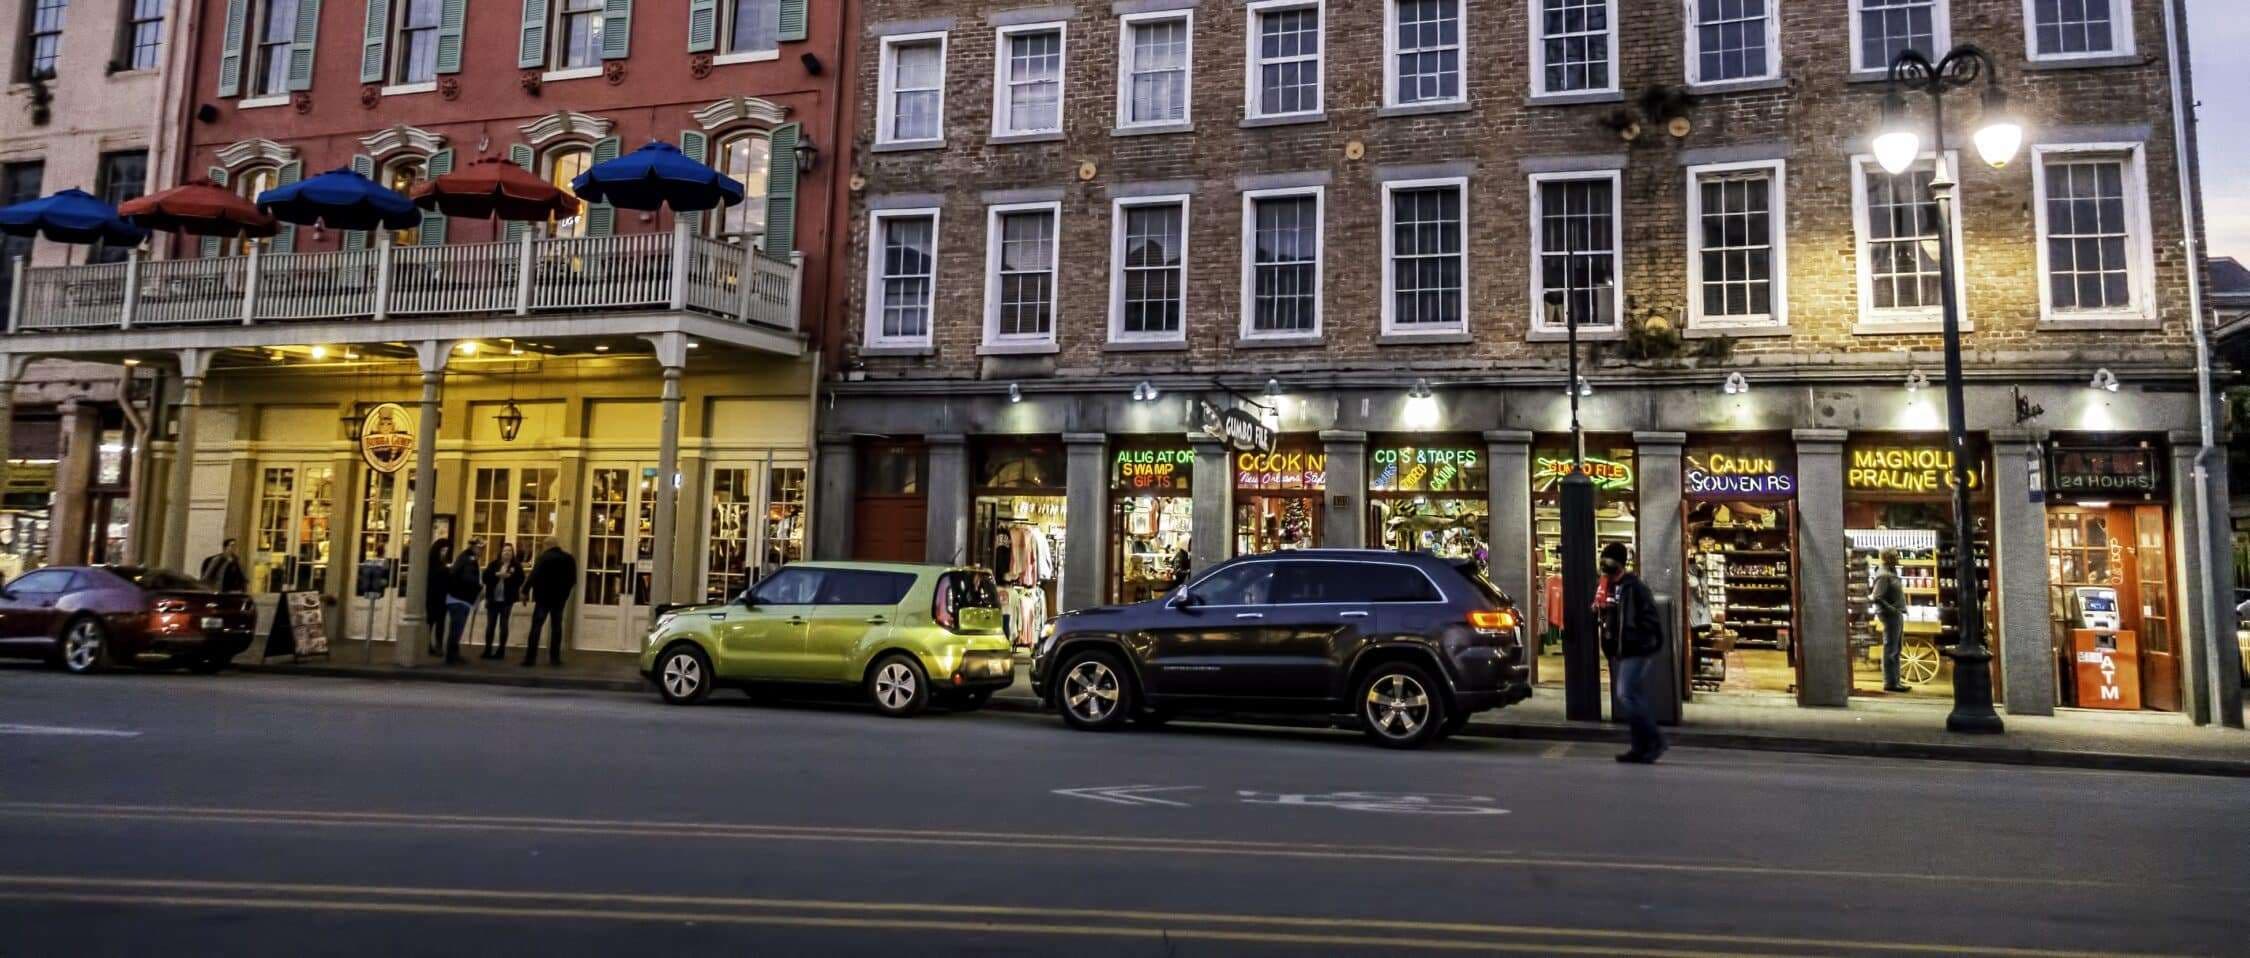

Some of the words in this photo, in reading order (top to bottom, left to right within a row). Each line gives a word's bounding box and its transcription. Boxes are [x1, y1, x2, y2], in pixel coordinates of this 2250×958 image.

[1226, 416, 1253, 442] GUMBO
[1255, 425, 1269, 451] FILE
[1117, 450, 1195, 463] ALLIGATOR
[1416, 450, 1427, 463] &
[1427, 450, 1477, 464] TAPES
[1710, 454, 1775, 473] CAJUN
[1855, 450, 1953, 469] MAGNOLI
[1123, 463, 1174, 476] SWAMP
[1430, 463, 1457, 490] CAJUN
[1548, 463, 1592, 476] GUMO
[1596, 463, 1625, 477] FILE
[1134, 476, 1171, 487] GIFTS
[1239, 471, 1258, 483] New
[1261, 472, 1301, 484] Orleans
[1304, 470, 1326, 486] Styl
[1849, 468, 1938, 493] PRALINE
[2061, 475, 2083, 487] 24
[2088, 475, 2150, 488] HOURS
[2100, 655, 2120, 700] ATM
